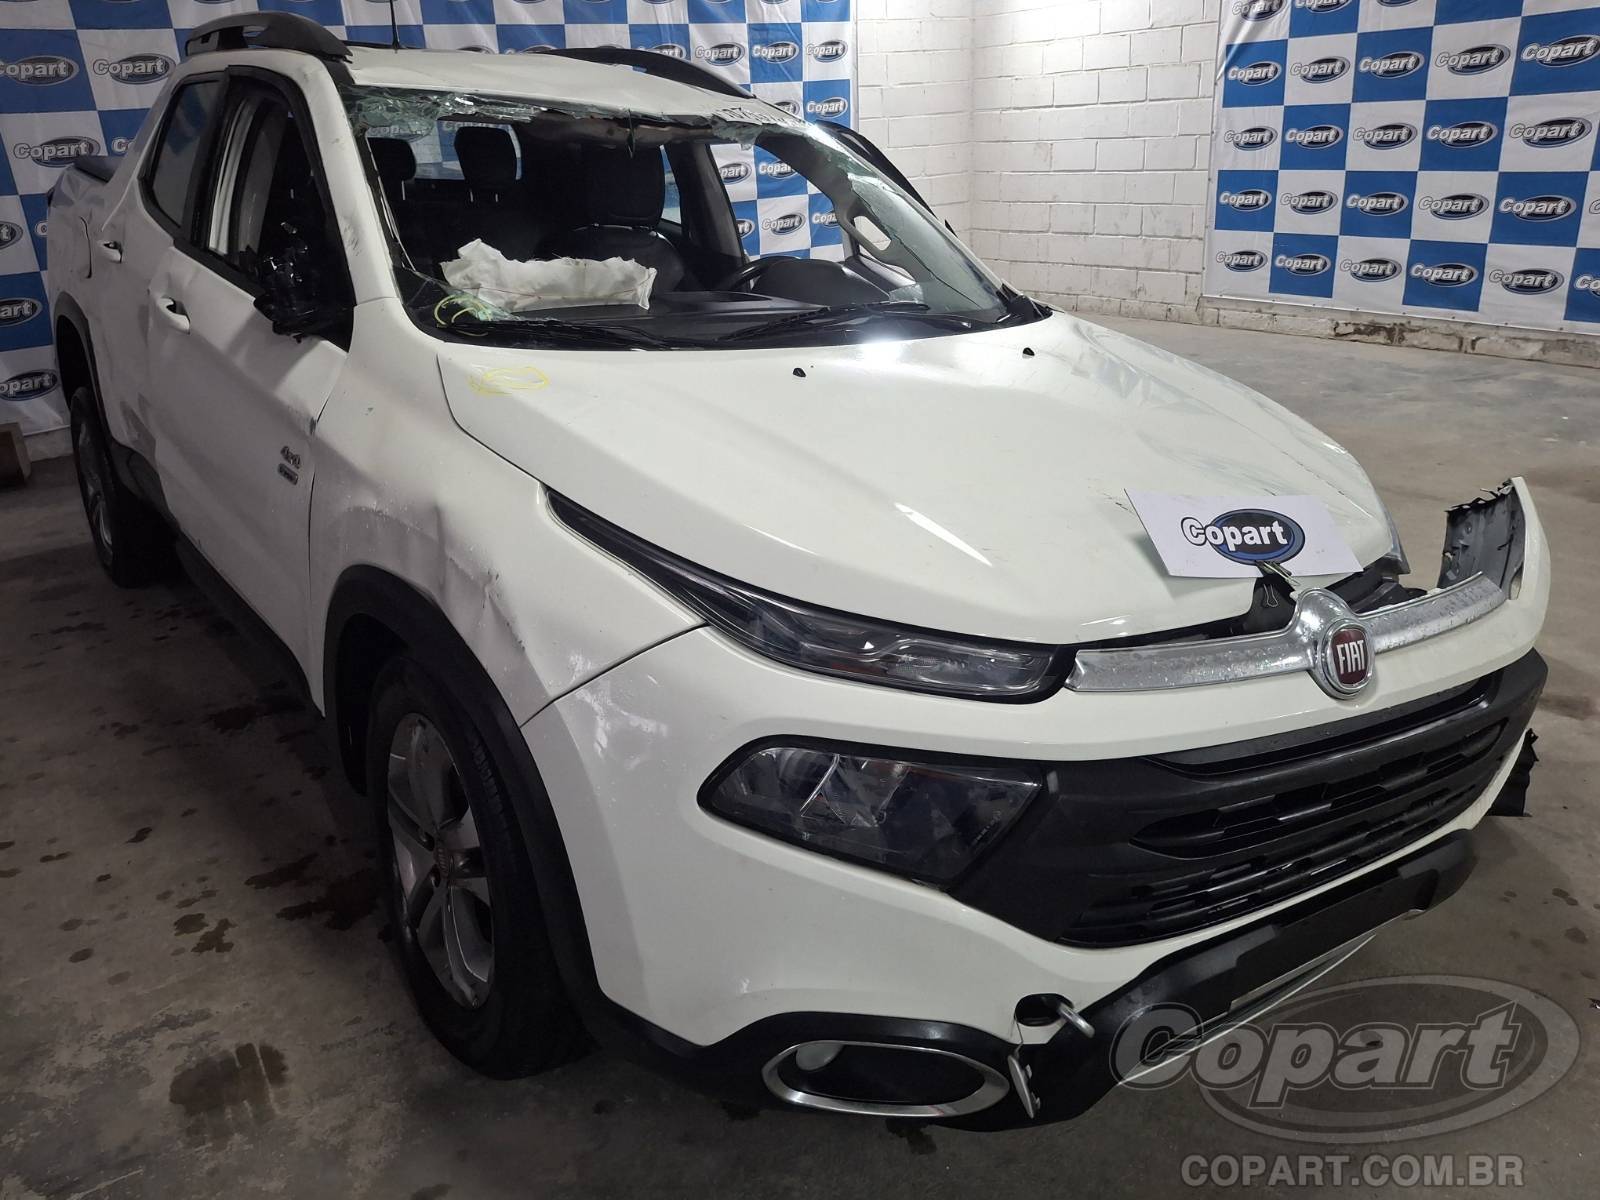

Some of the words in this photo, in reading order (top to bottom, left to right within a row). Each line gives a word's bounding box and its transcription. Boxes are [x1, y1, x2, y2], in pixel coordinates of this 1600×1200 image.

[695, 45, 739, 61] Copart
[752, 43, 793, 59] Copart
[806, 43, 846, 58] Copart
[1521, 39, 1595, 62] Copart
[1360, 57, 1416, 76] Copart
[1436, 49, 1499, 70] Copart
[93, 59, 165, 78] Copart
[1228, 65, 1275, 82] Copart
[1290, 61, 1341, 80] Copart
[808, 100, 845, 116] Copart
[1224, 128, 1271, 144] Copart
[1285, 127, 1335, 143] Copart
[1353, 126, 1408, 143] Copart
[1427, 123, 1488, 142] Copart
[1510, 120, 1582, 142] Copart
[14, 141, 89, 161] Copart
[1220, 192, 1266, 208] Copart
[1280, 192, 1330, 209] Copart
[1347, 193, 1400, 210] Copart
[1419, 196, 1480, 215] Copart
[1500, 197, 1568, 216] Copart
[762, 214, 801, 231] Copart
[1216, 250, 1260, 267] Copart
[1275, 255, 1326, 271] Copart
[1340, 260, 1394, 276] Copart
[1411, 263, 1469, 282] Copart
[1489, 269, 1554, 288] Copart
[1181, 516, 1288, 551] Copart
[1336, 639, 1366, 675] FIAT
